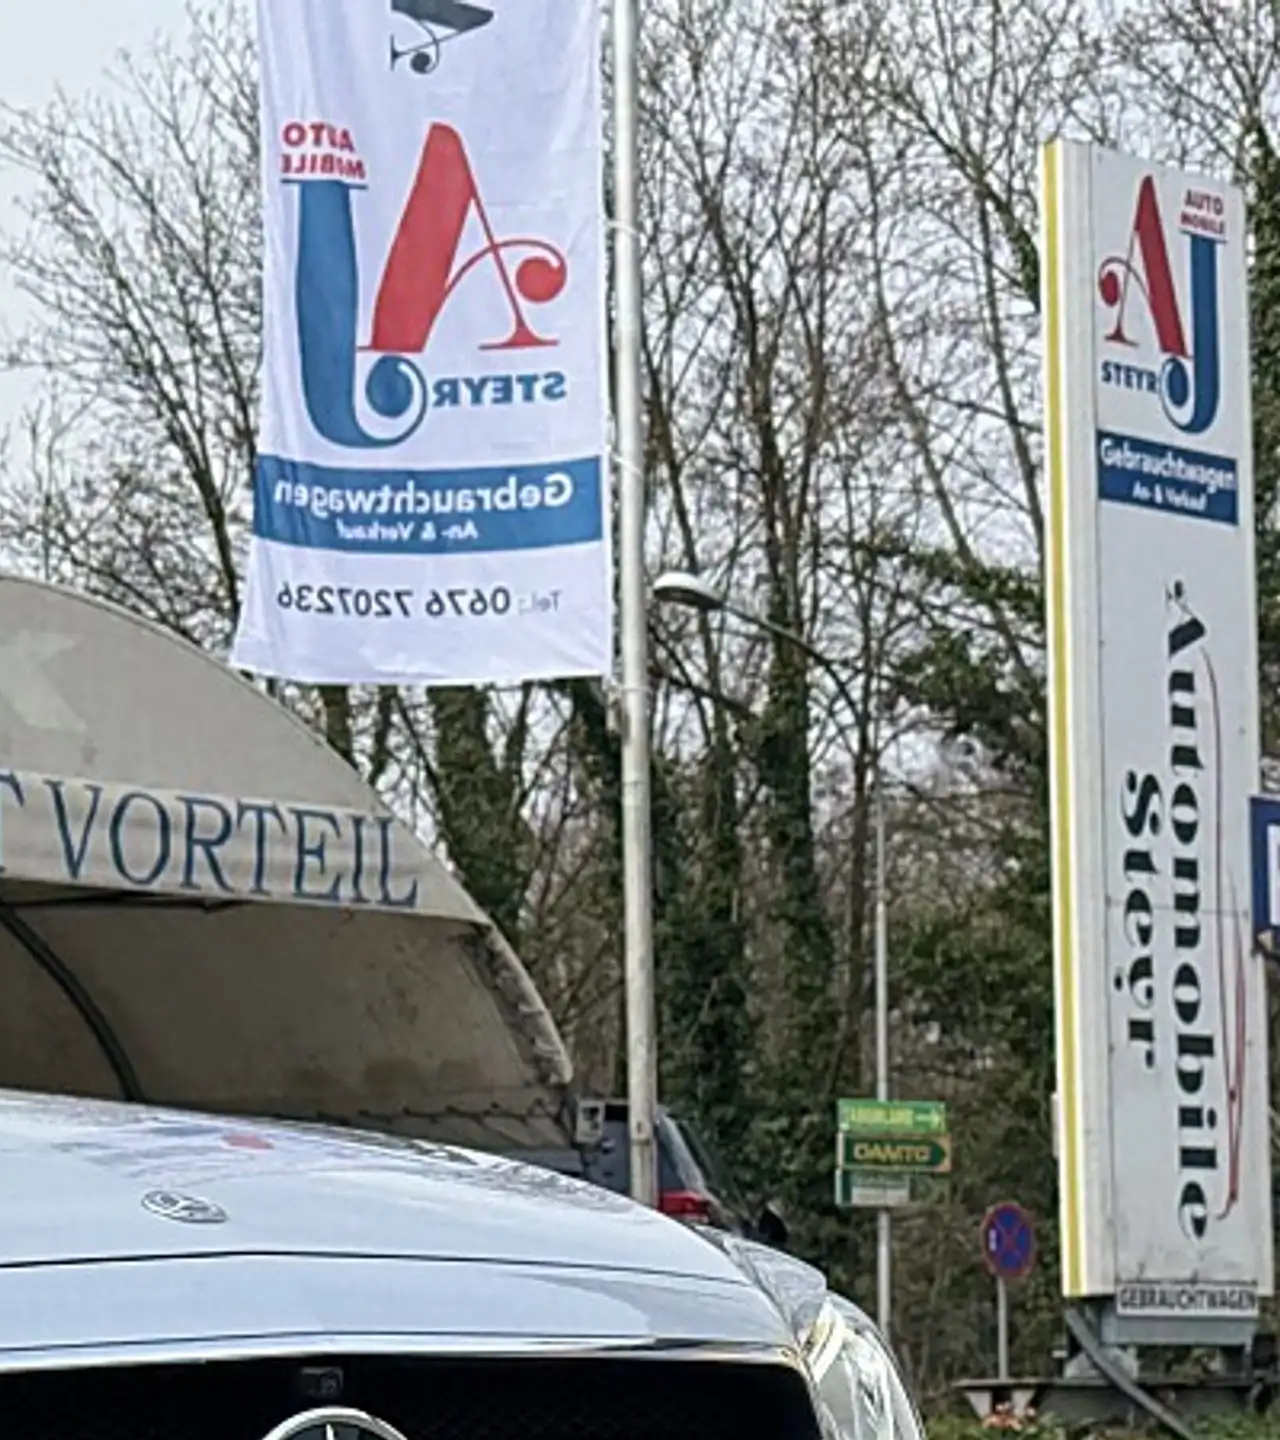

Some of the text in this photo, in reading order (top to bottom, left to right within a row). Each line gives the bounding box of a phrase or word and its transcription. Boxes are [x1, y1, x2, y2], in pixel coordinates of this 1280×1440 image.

[1100, 438, 1236, 493] Gebrauchtwagen
[44, 779, 418, 908] VORTEIL
[1114, 768, 1164, 1068] Steyr
[1164, 577, 1218, 1243] Automobile
